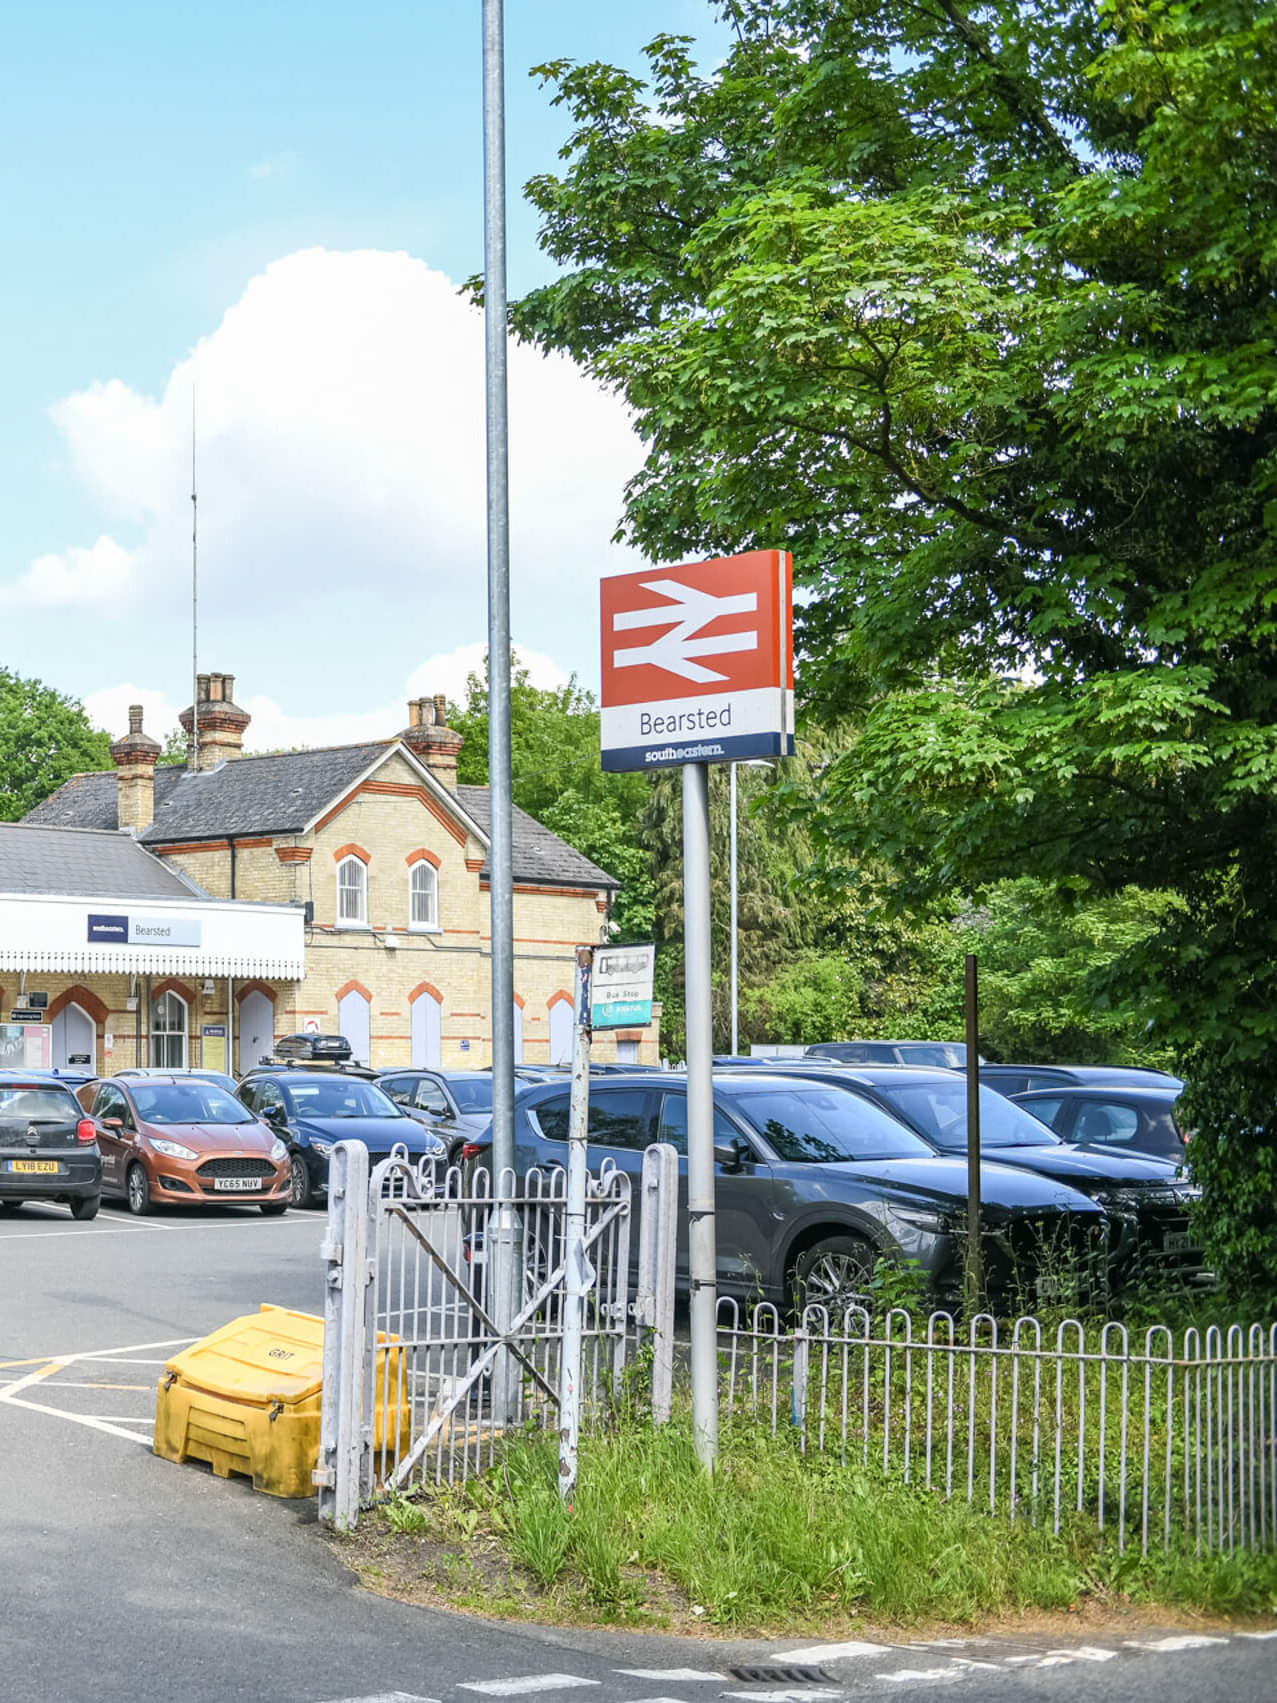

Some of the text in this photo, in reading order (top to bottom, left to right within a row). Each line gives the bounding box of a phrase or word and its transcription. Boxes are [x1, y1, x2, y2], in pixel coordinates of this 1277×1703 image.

[640, 702, 732, 736] Bearsted
[135, 924, 171, 937] Bearsted
[268, 1348, 295, 1360] GRIT
